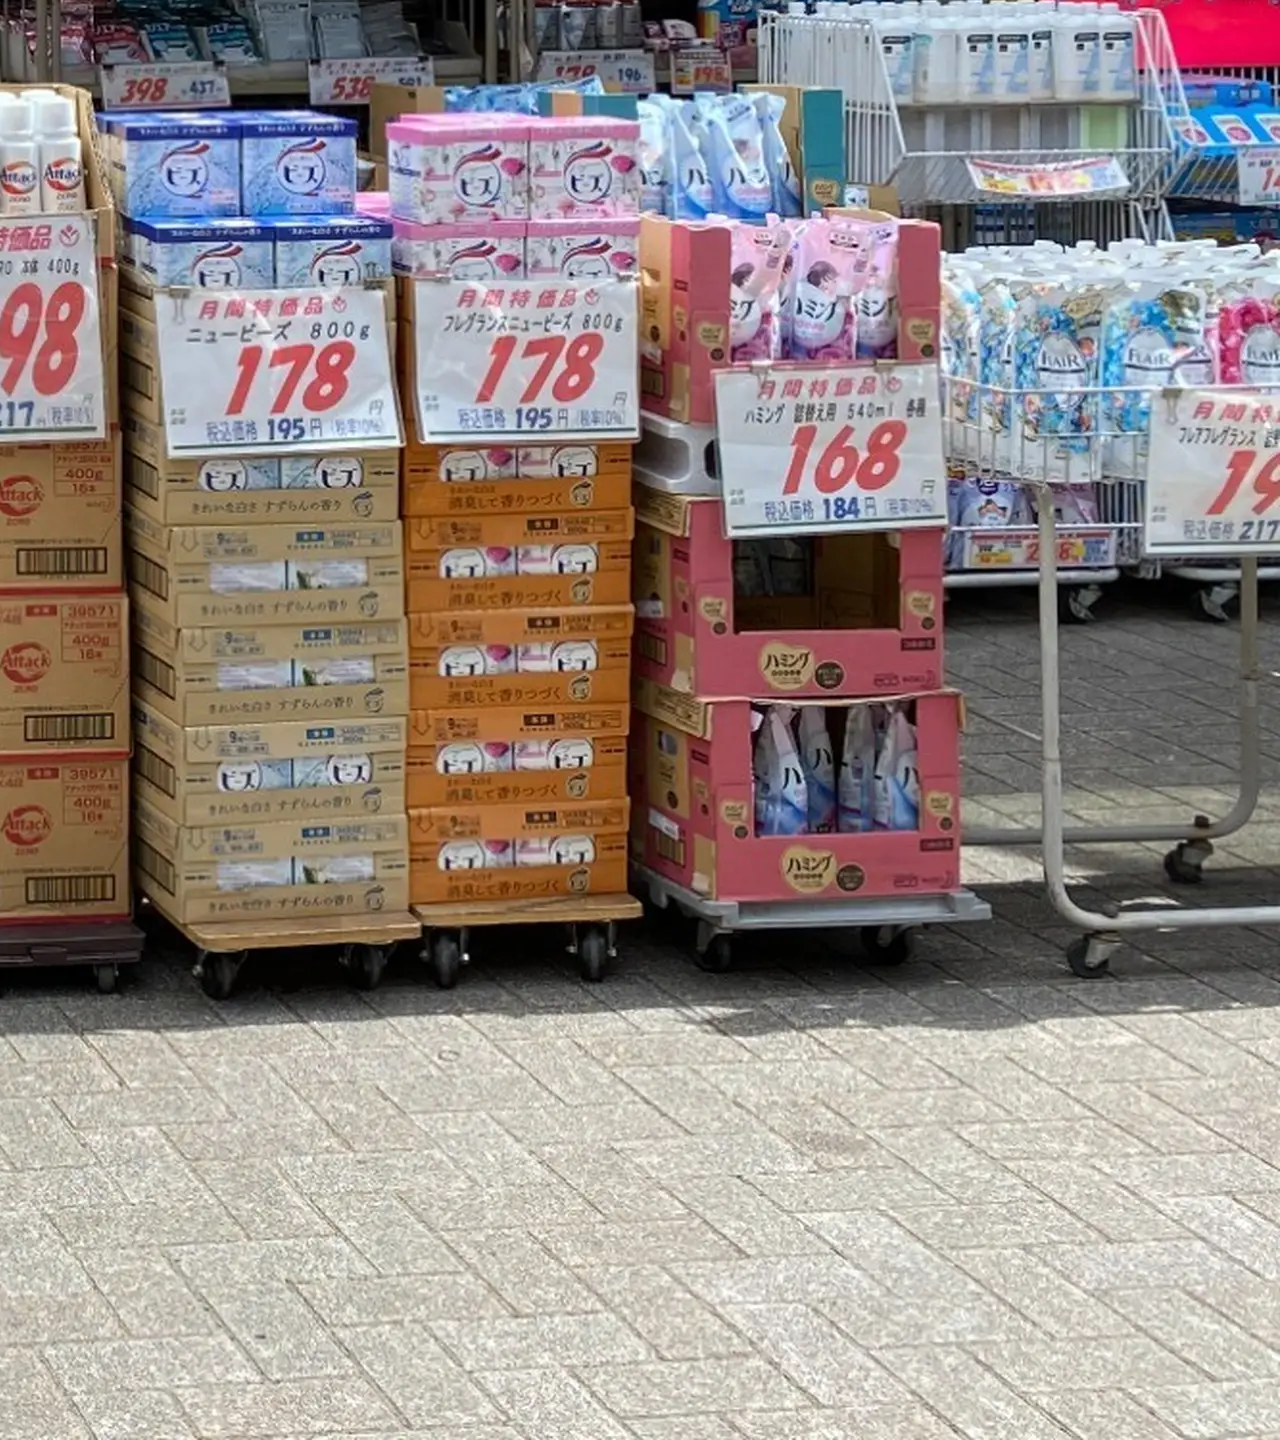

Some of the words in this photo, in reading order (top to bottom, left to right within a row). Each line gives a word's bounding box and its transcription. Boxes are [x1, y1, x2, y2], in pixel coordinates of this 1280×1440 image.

[119, 77, 167, 102] 398
[43, 165, 83, 183] Attack
[570, 171, 605, 193] ビーズ
[46, 258, 81, 276] 400g
[198, 295, 324, 320] 月間特価品
[456, 288, 578, 309] 月間特価品
[186, 322, 293, 345] ニュービーズ
[309, 321, 371, 340] 800g
[443, 310, 573, 334] フレグランスニュービーズ
[582, 312, 624, 333] 800g
[225, 339, 357, 417] 178
[475, 331, 605, 405] 178
[756, 376, 878, 401] 月間特価品
[514, 406, 553, 429] 195
[743, 404, 786, 426] ハミング
[266, 417, 307, 441] 195
[781, 419, 909, 496] 168
[821, 497, 861, 520] 184
[1240, 519, 1278, 541] 217
[762, 650, 812, 671] ハミング
[0, 813, 53, 833] Attack
[785, 854, 833, 875] ハミング
